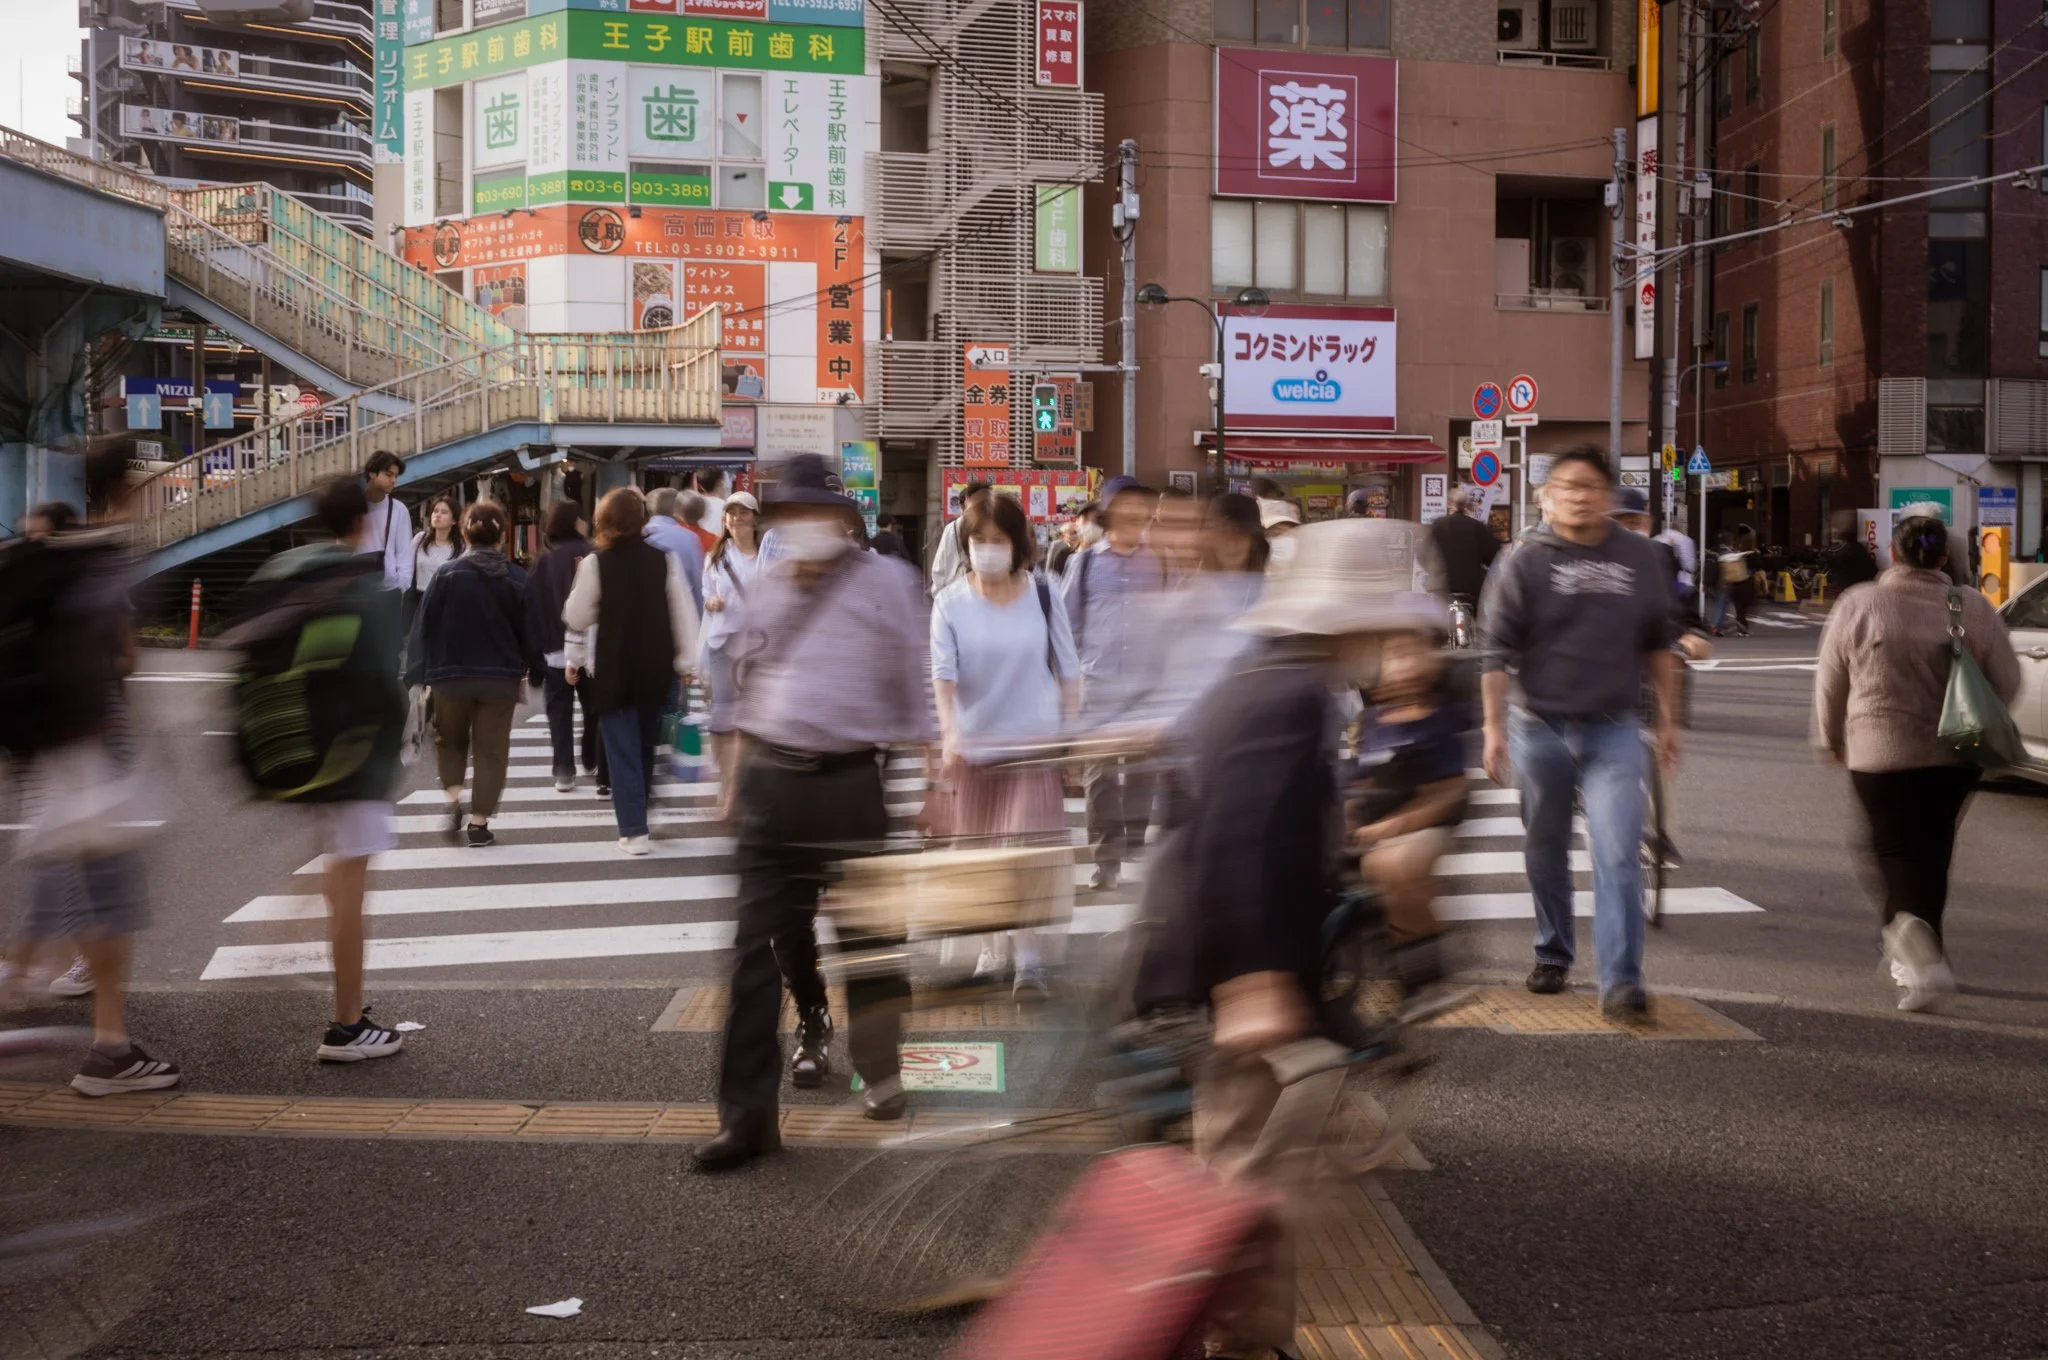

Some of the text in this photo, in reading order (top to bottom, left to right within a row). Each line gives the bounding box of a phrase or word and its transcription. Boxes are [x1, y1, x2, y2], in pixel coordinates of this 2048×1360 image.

[1042, 9, 1076, 22] スマホ
[602, 22, 836, 62] 王子駅前歯科
[1045, 28, 1073, 43] 買取
[412, 23, 558, 80] 王子駅前歯科
[380, 50, 399, 140] リフォーム
[484, 92, 520, 149] 歯
[606, 76, 619, 161] インプラント
[642, 85, 700, 141] 歯
[1268, 81, 1348, 170] 薬
[782, 79, 800, 177] エレベーター
[828, 79, 848, 209] 王子駅前歯科
[580, 222, 624, 241] 買取
[664, 214, 775, 240] 高価買取
[686, 267, 730, 278] ヴィトン
[686, 285, 735, 295] エルメス
[982, 349, 1005, 362] 入口
[1235, 333, 1377, 363] コクミンドラッグ
[965, 384, 1009, 406] 金券
[1277, 370, 1336, 399] welcia
[966, 419, 1009, 438] 買取
[966, 442, 1009, 460] 販売
